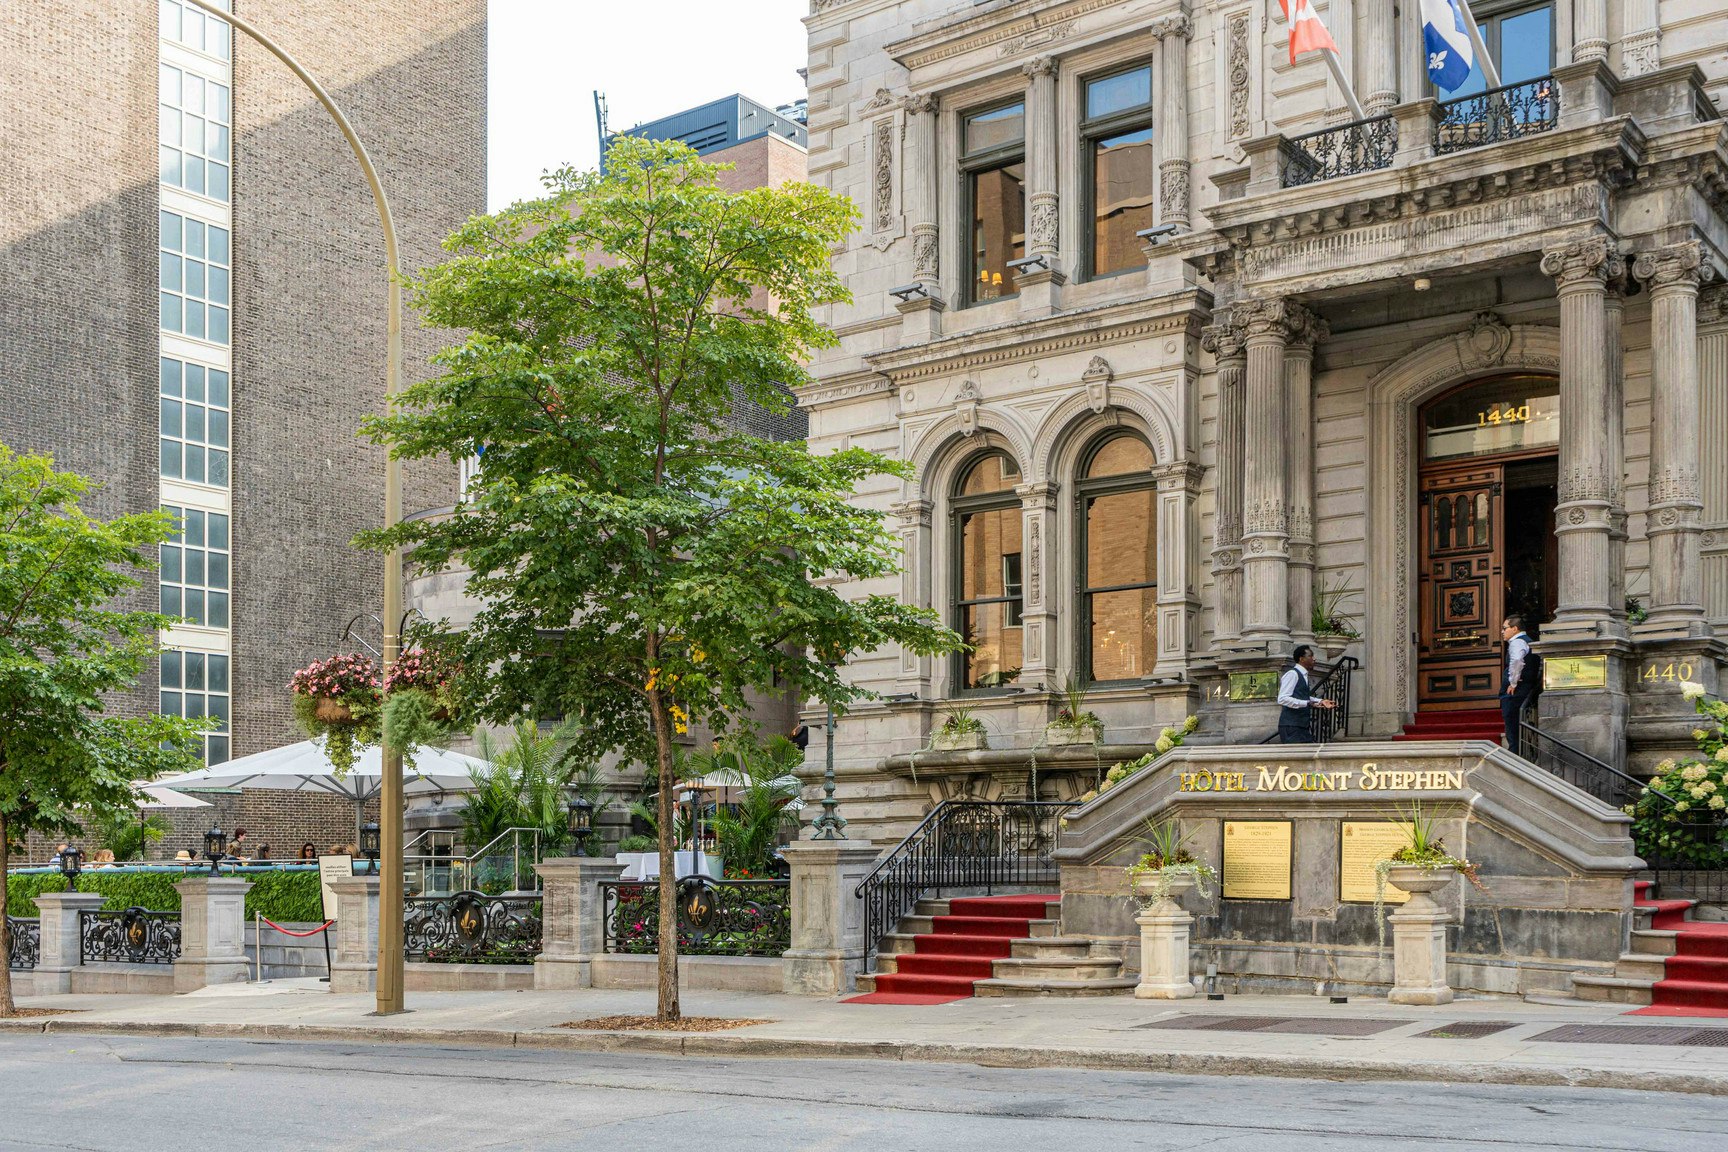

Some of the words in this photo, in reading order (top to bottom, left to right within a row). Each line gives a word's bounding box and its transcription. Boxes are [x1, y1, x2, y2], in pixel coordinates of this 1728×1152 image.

[1478, 405, 1530, 427] 1440
[1635, 662, 1693, 684] 1440
[1180, 767, 1249, 792] HÔTEL
[1255, 765, 1352, 791] MOUNT
[1359, 763, 1464, 790] STEPHEN
